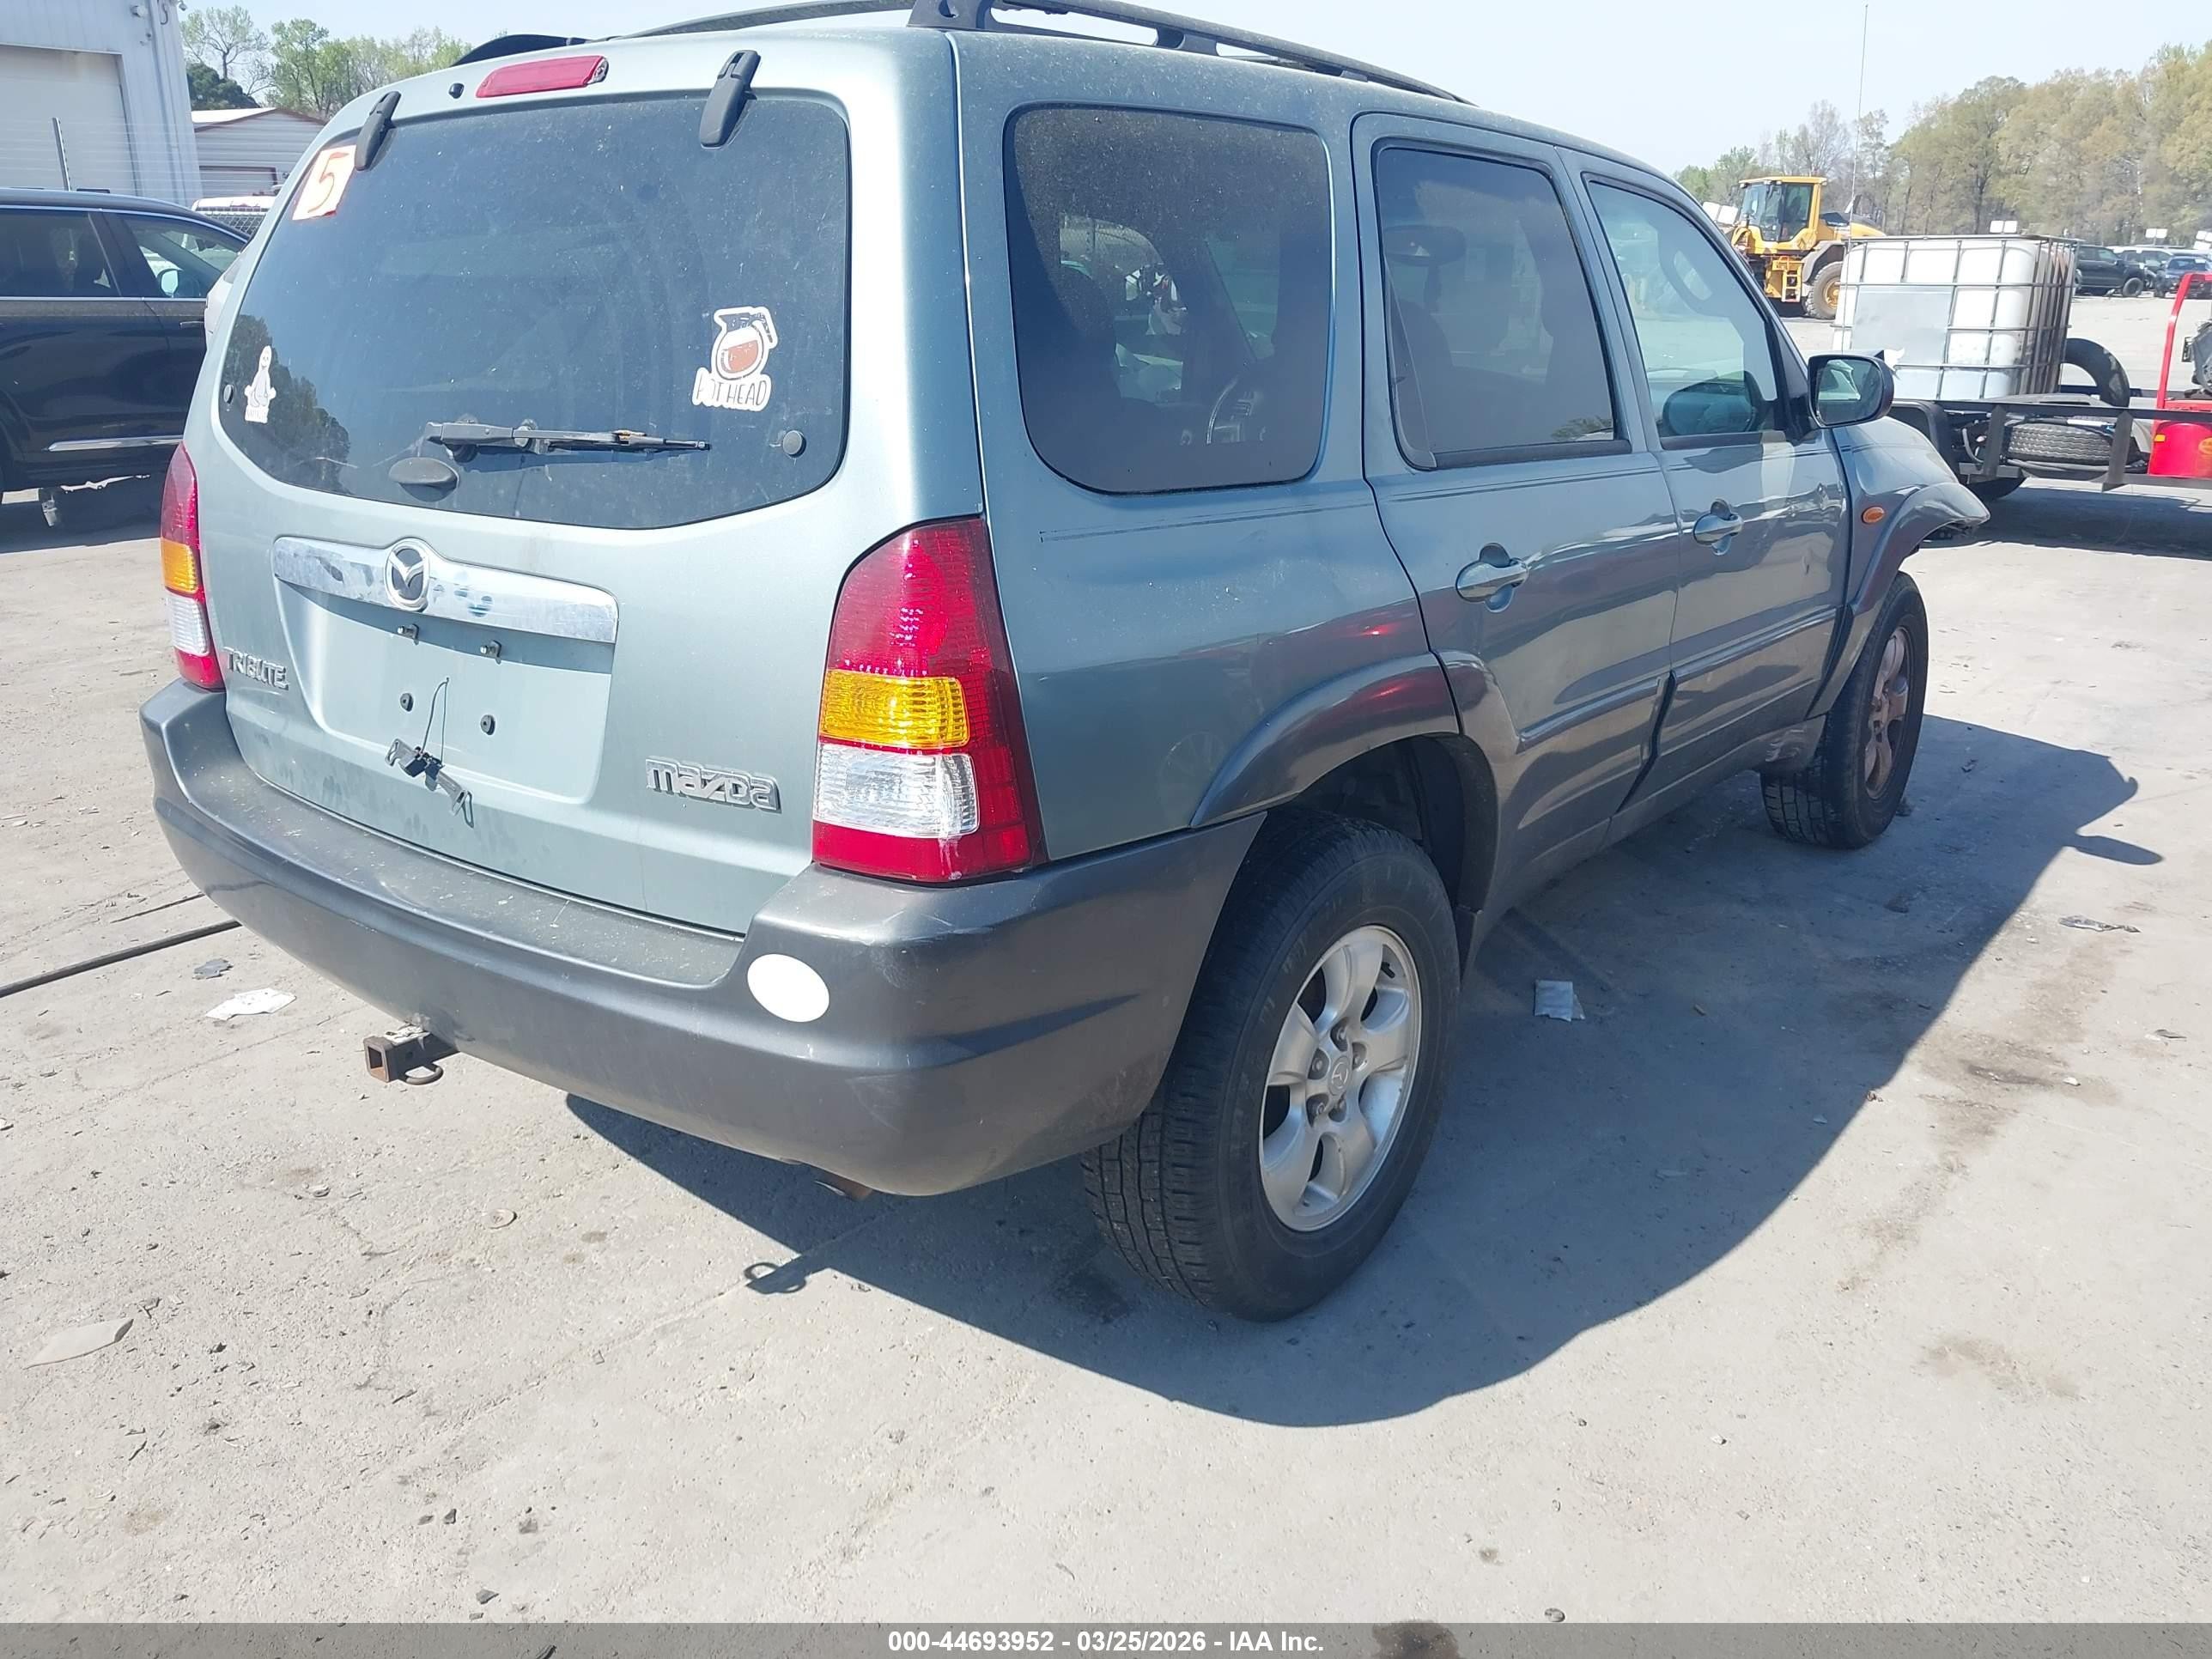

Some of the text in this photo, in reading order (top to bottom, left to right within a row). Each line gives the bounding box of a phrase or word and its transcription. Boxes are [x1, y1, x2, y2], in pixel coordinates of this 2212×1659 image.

[307, 152, 349, 213] 5
[726, 380, 767, 405] HEAD
[223, 647, 289, 690] TRIBUTE
